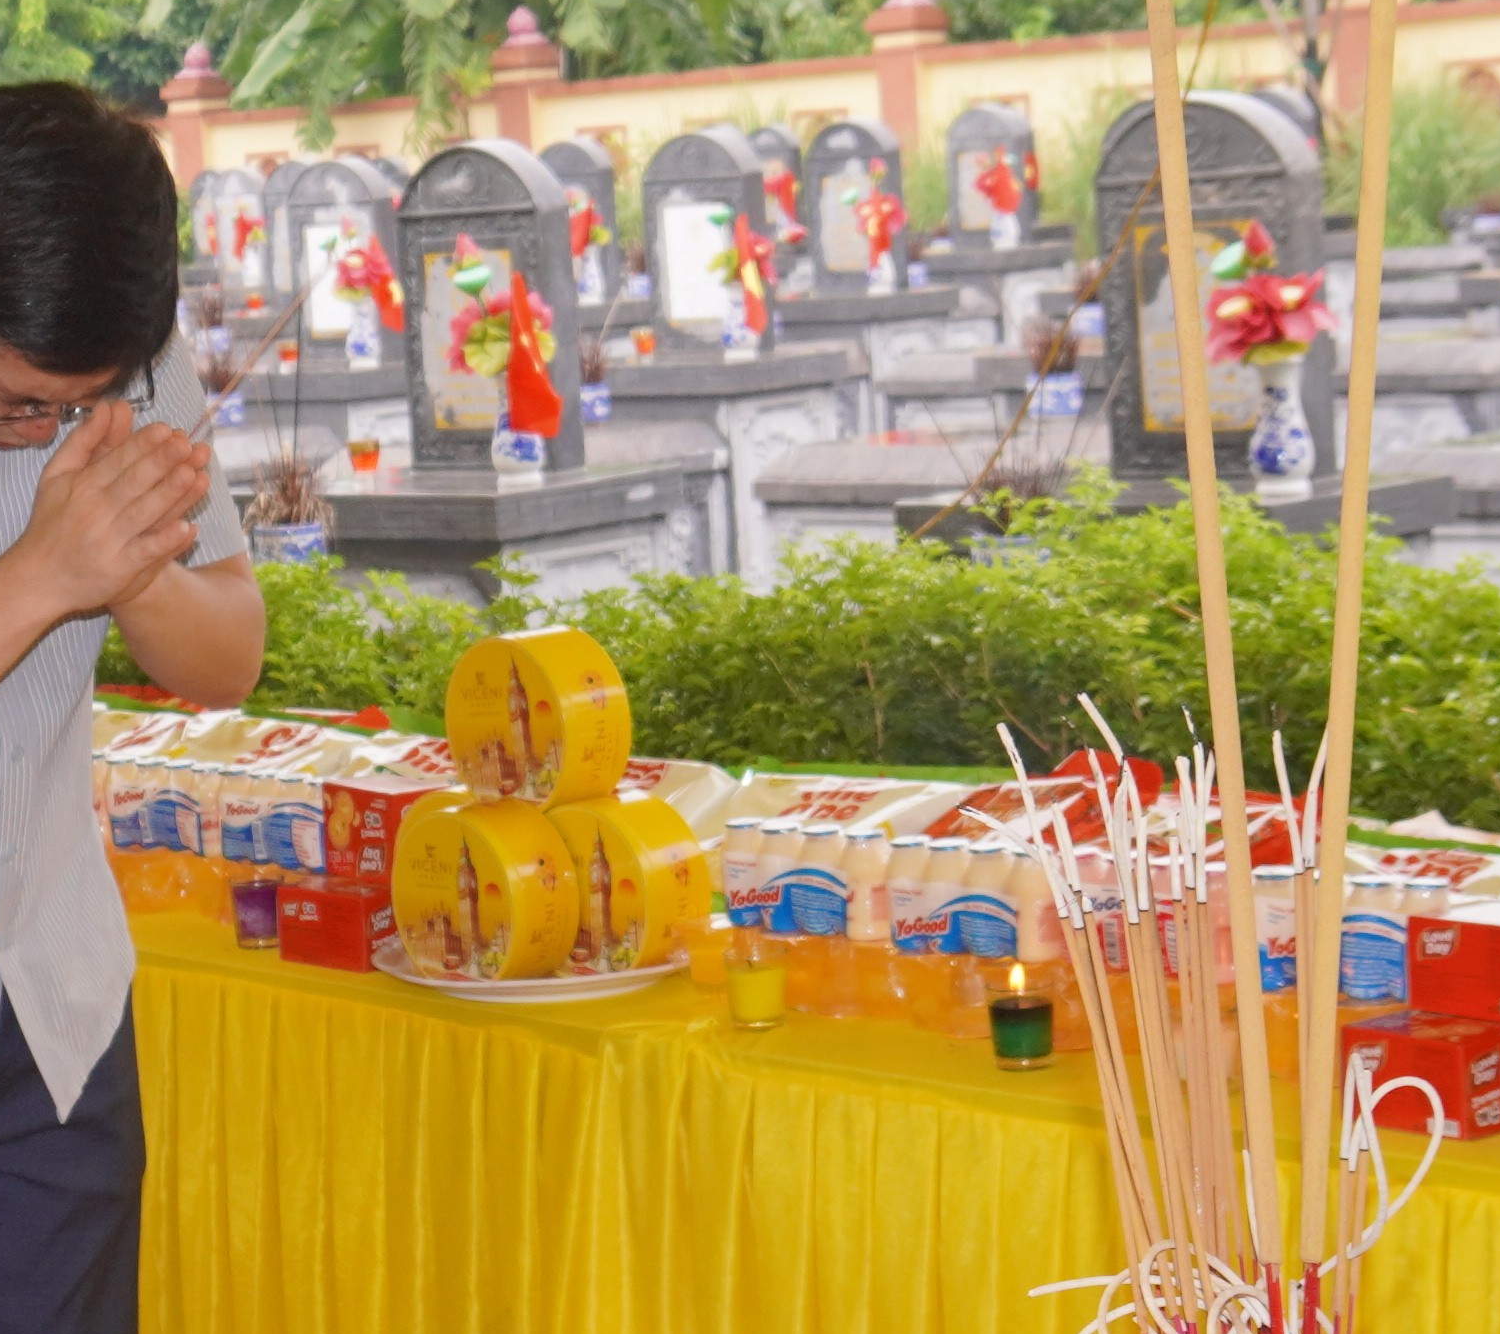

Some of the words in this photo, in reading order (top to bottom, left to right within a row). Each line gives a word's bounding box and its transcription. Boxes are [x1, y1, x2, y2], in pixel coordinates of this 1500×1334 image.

[226, 802, 261, 817] YoGood
[729, 886, 782, 908] YoGood
[895, 913, 949, 937] YoGood
